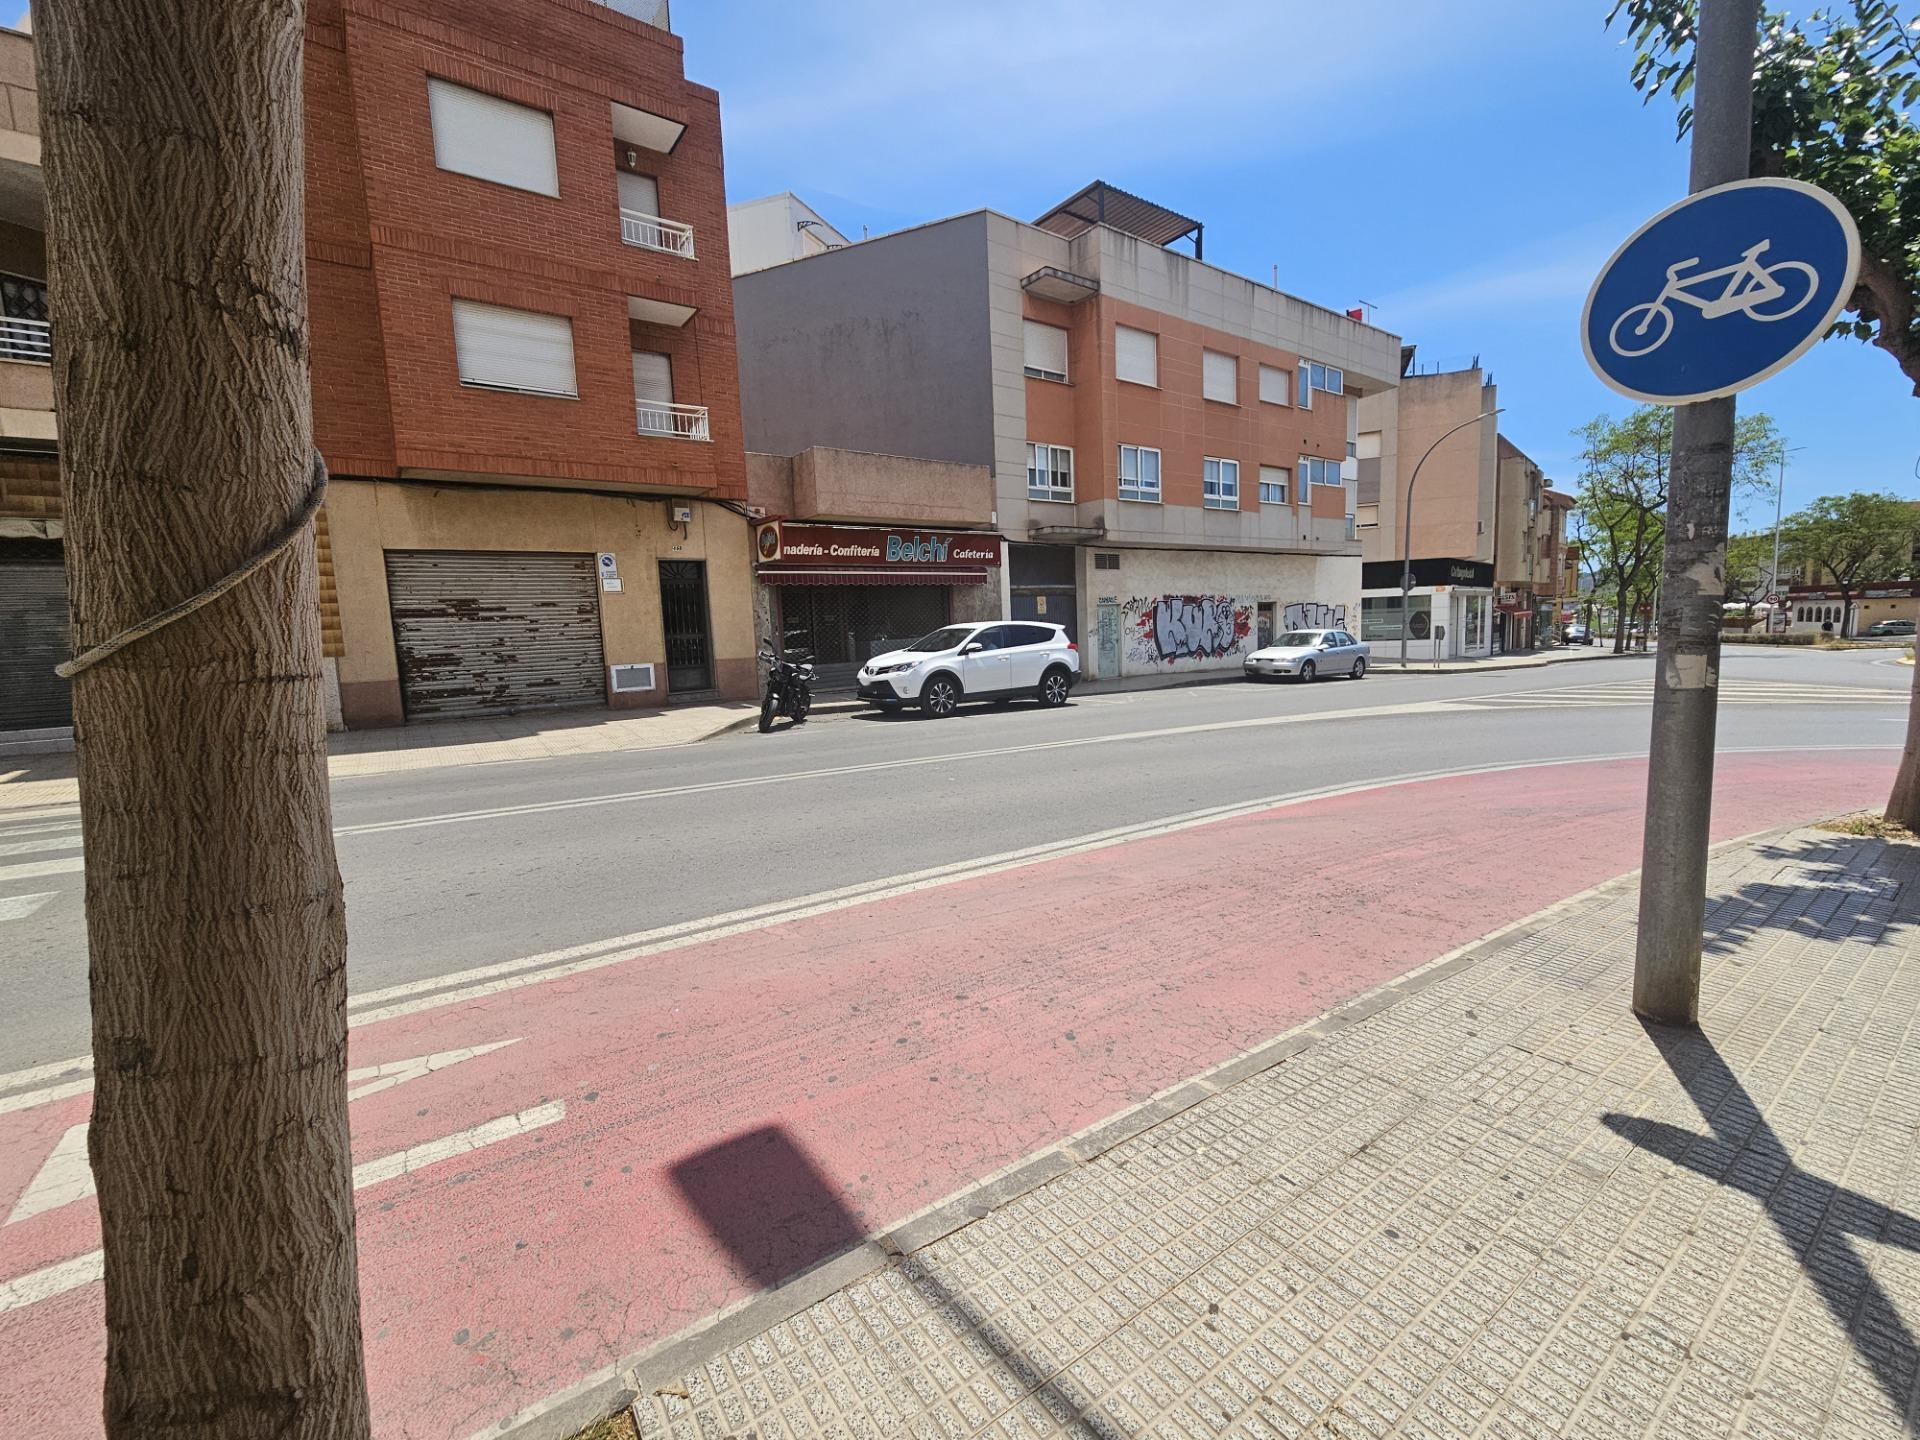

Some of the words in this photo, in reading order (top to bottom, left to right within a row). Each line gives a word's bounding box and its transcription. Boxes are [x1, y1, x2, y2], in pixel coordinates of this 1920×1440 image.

[829, 544, 880, 557] Confitería
[886, 535, 953, 562] Belchí
[953, 548, 994, 559] Cafetería
